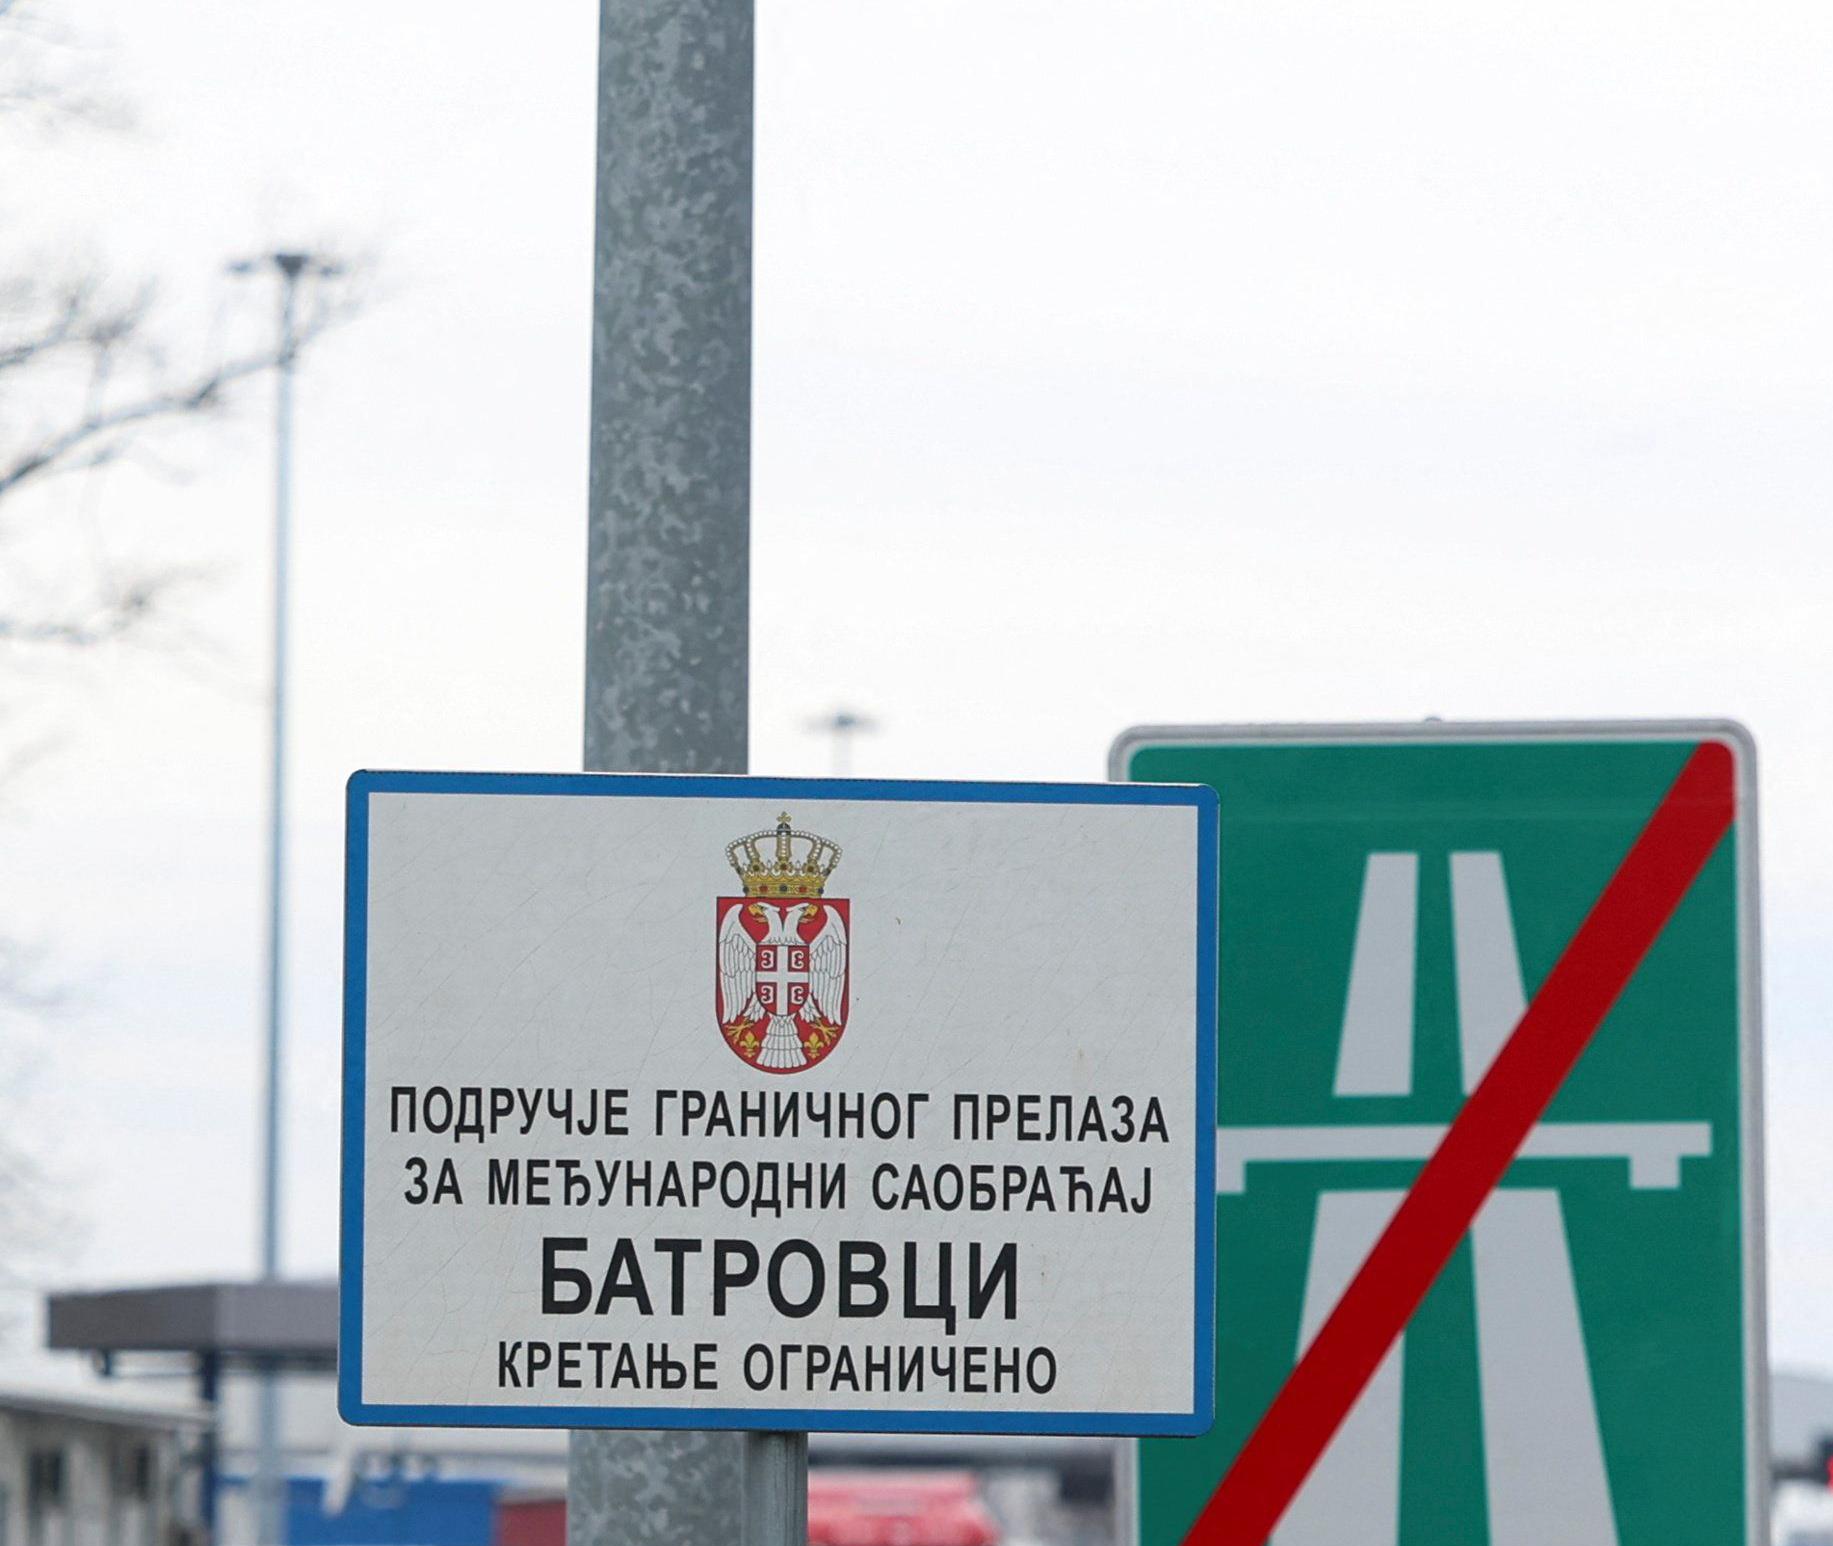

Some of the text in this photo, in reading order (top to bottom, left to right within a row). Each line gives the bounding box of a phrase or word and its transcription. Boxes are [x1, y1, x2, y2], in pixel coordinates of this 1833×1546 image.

[390, 1086, 1170, 1144] ПОДРУЧЈЕ ГРАНИЧНОГ ПРЕЛАЗА
[404, 1156, 1151, 1219] ЗА МЕЂУНАРОДНИ САОБРАЋАЈ
[541, 1236, 1018, 1336] БАТРОВЦИ
[498, 1340, 1057, 1395] КРЕТАЊЕ ОГРАНИЧЕНО
